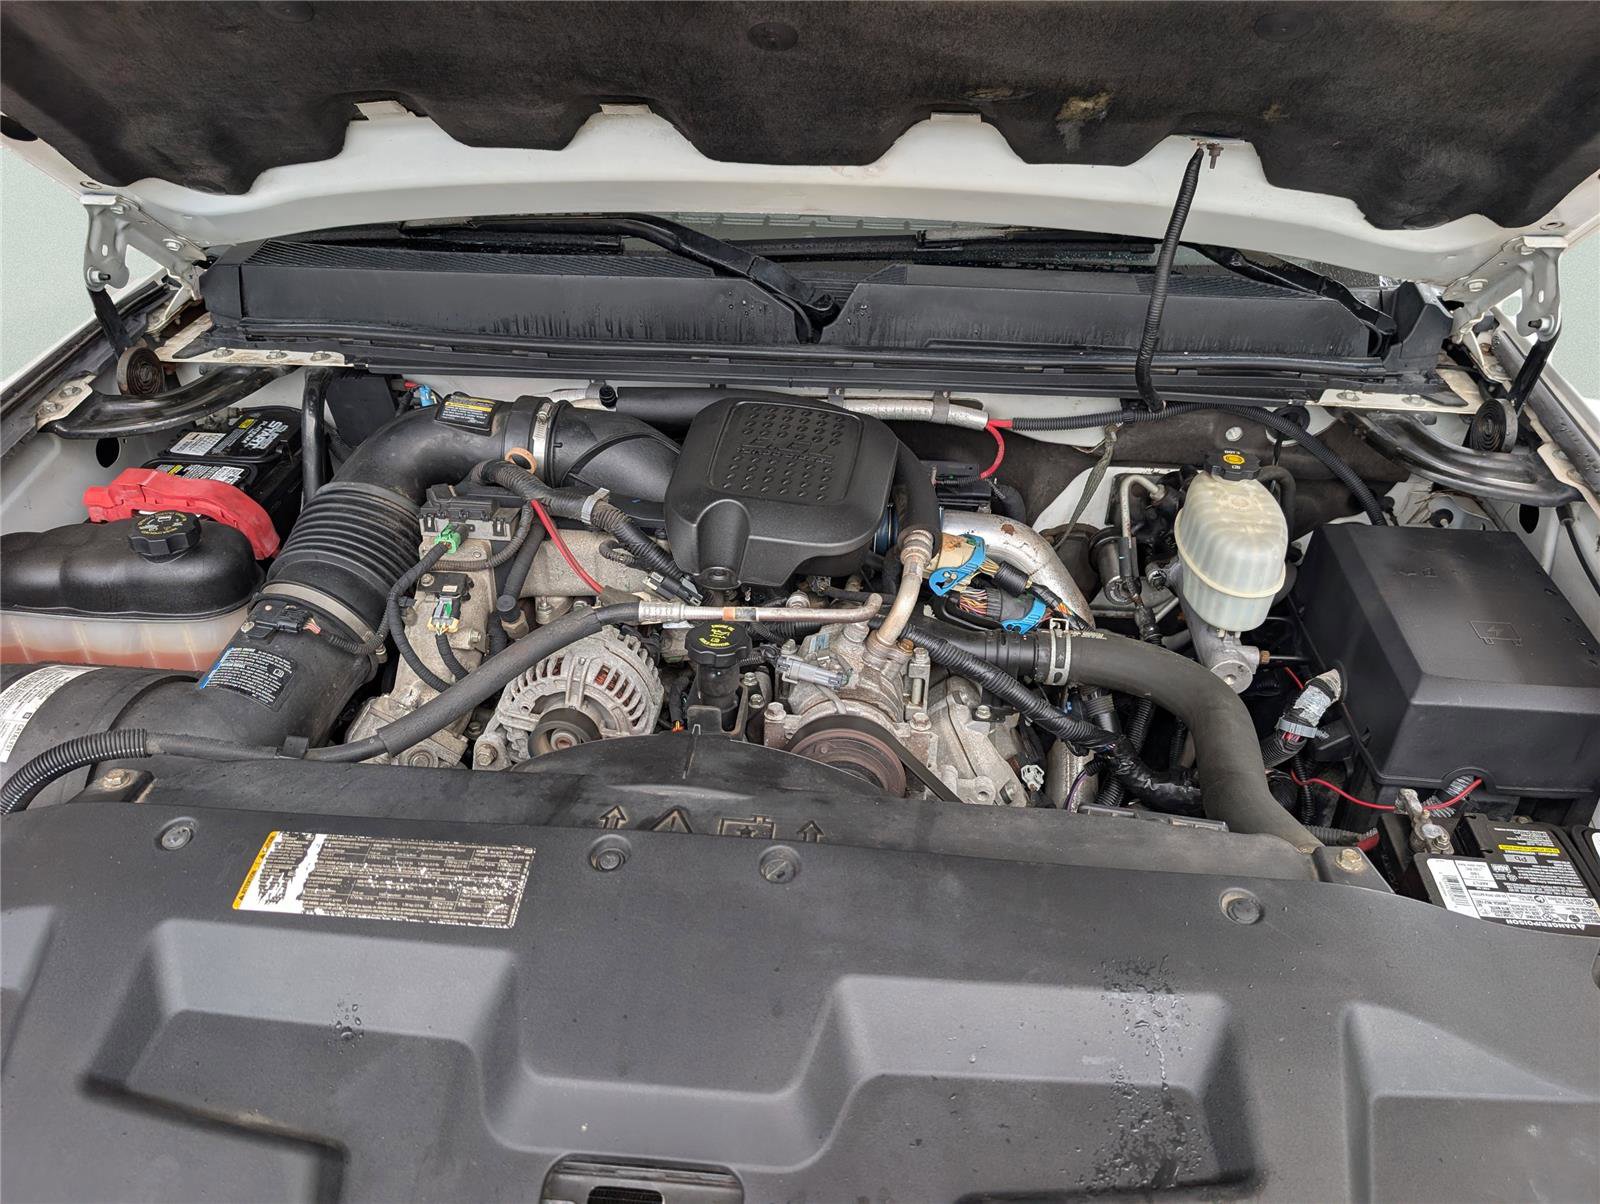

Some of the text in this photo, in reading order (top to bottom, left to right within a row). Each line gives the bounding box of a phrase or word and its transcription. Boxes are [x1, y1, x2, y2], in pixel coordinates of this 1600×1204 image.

[247, 420, 282, 450] START
[5, 724, 25, 752] CATALYST
[1514, 855, 1529, 863] Pb
[1506, 919, 1579, 930] DANGER/POISON
